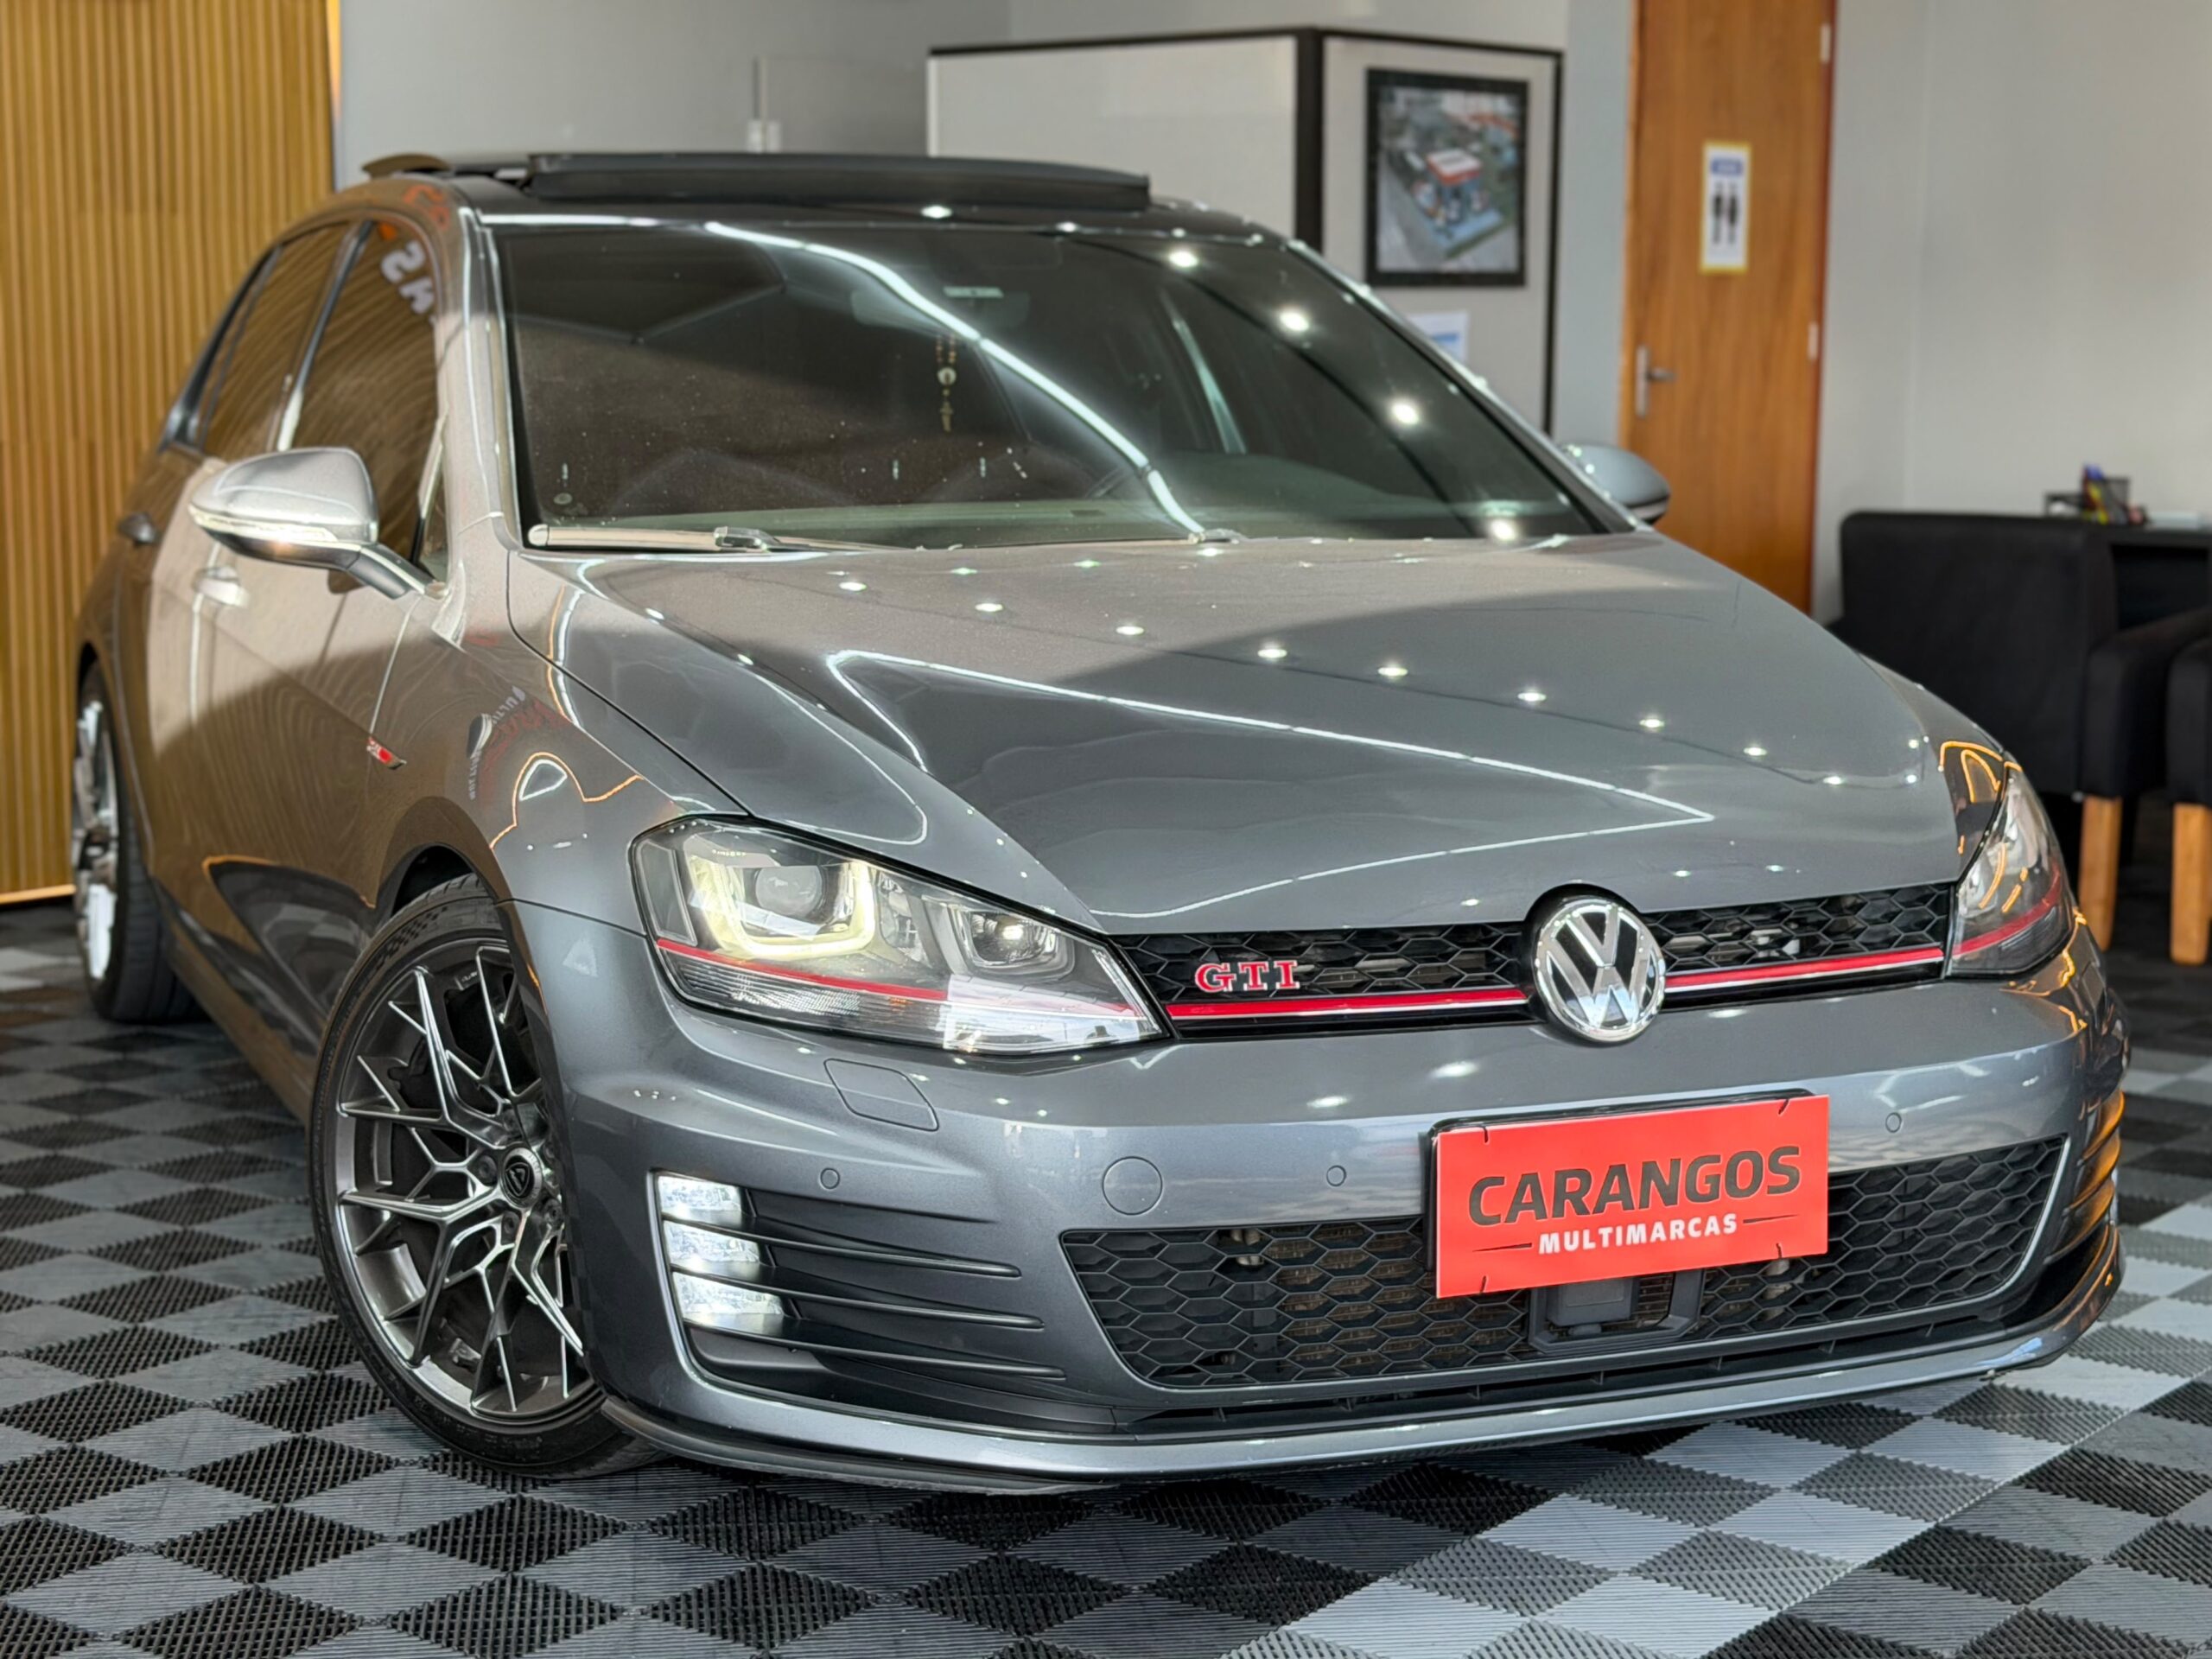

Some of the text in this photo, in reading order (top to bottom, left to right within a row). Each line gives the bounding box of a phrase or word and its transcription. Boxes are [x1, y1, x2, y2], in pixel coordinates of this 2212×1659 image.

[1194, 960, 1300, 993] GTI
[1470, 1146, 1801, 1226] CARANGOS
[1539, 1213, 1737, 1254] MULTIMARCAS
